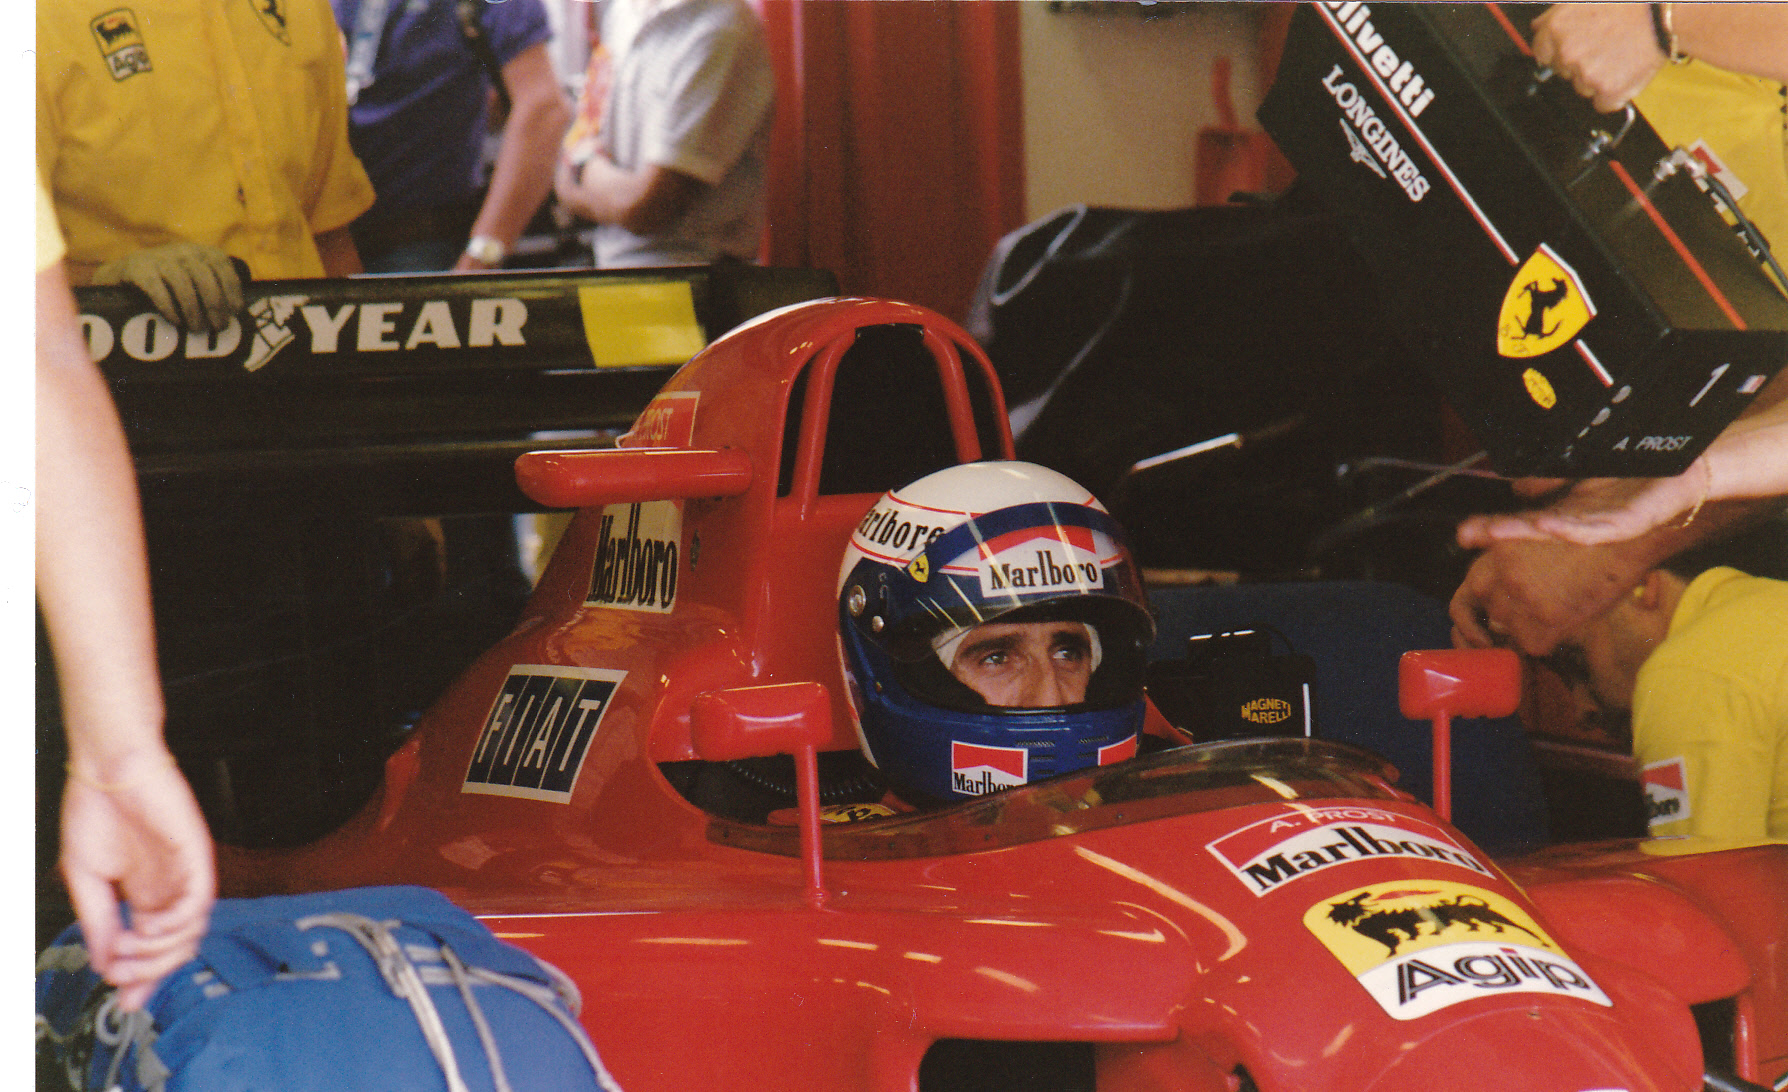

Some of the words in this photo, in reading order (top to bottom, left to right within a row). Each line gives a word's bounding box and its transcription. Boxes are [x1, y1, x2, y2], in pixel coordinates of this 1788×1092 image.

[1326, 2, 1435, 118] livetti
[1321, 63, 1431, 202] LONGINES
[78, 312, 242, 362] OOD
[1689, 363, 1730, 407] 1
[1635, 435, 1693, 451] PROST
[859, 508, 945, 551] arlbor
[586, 503, 678, 609] Marlboro
[988, 550, 1098, 590] Marlboro
[1241, 698, 1291, 714] MAGNETI
[1241, 708, 1291, 723] MARELLI
[476, 692, 602, 773] FIAT
[953, 771, 1015, 795] Marlbo
[1270, 820, 1302, 833] A.
[1308, 808, 1396, 822] PROST
[1241, 826, 1485, 891] Marlboro
[1397, 947, 1591, 1006] Agip
